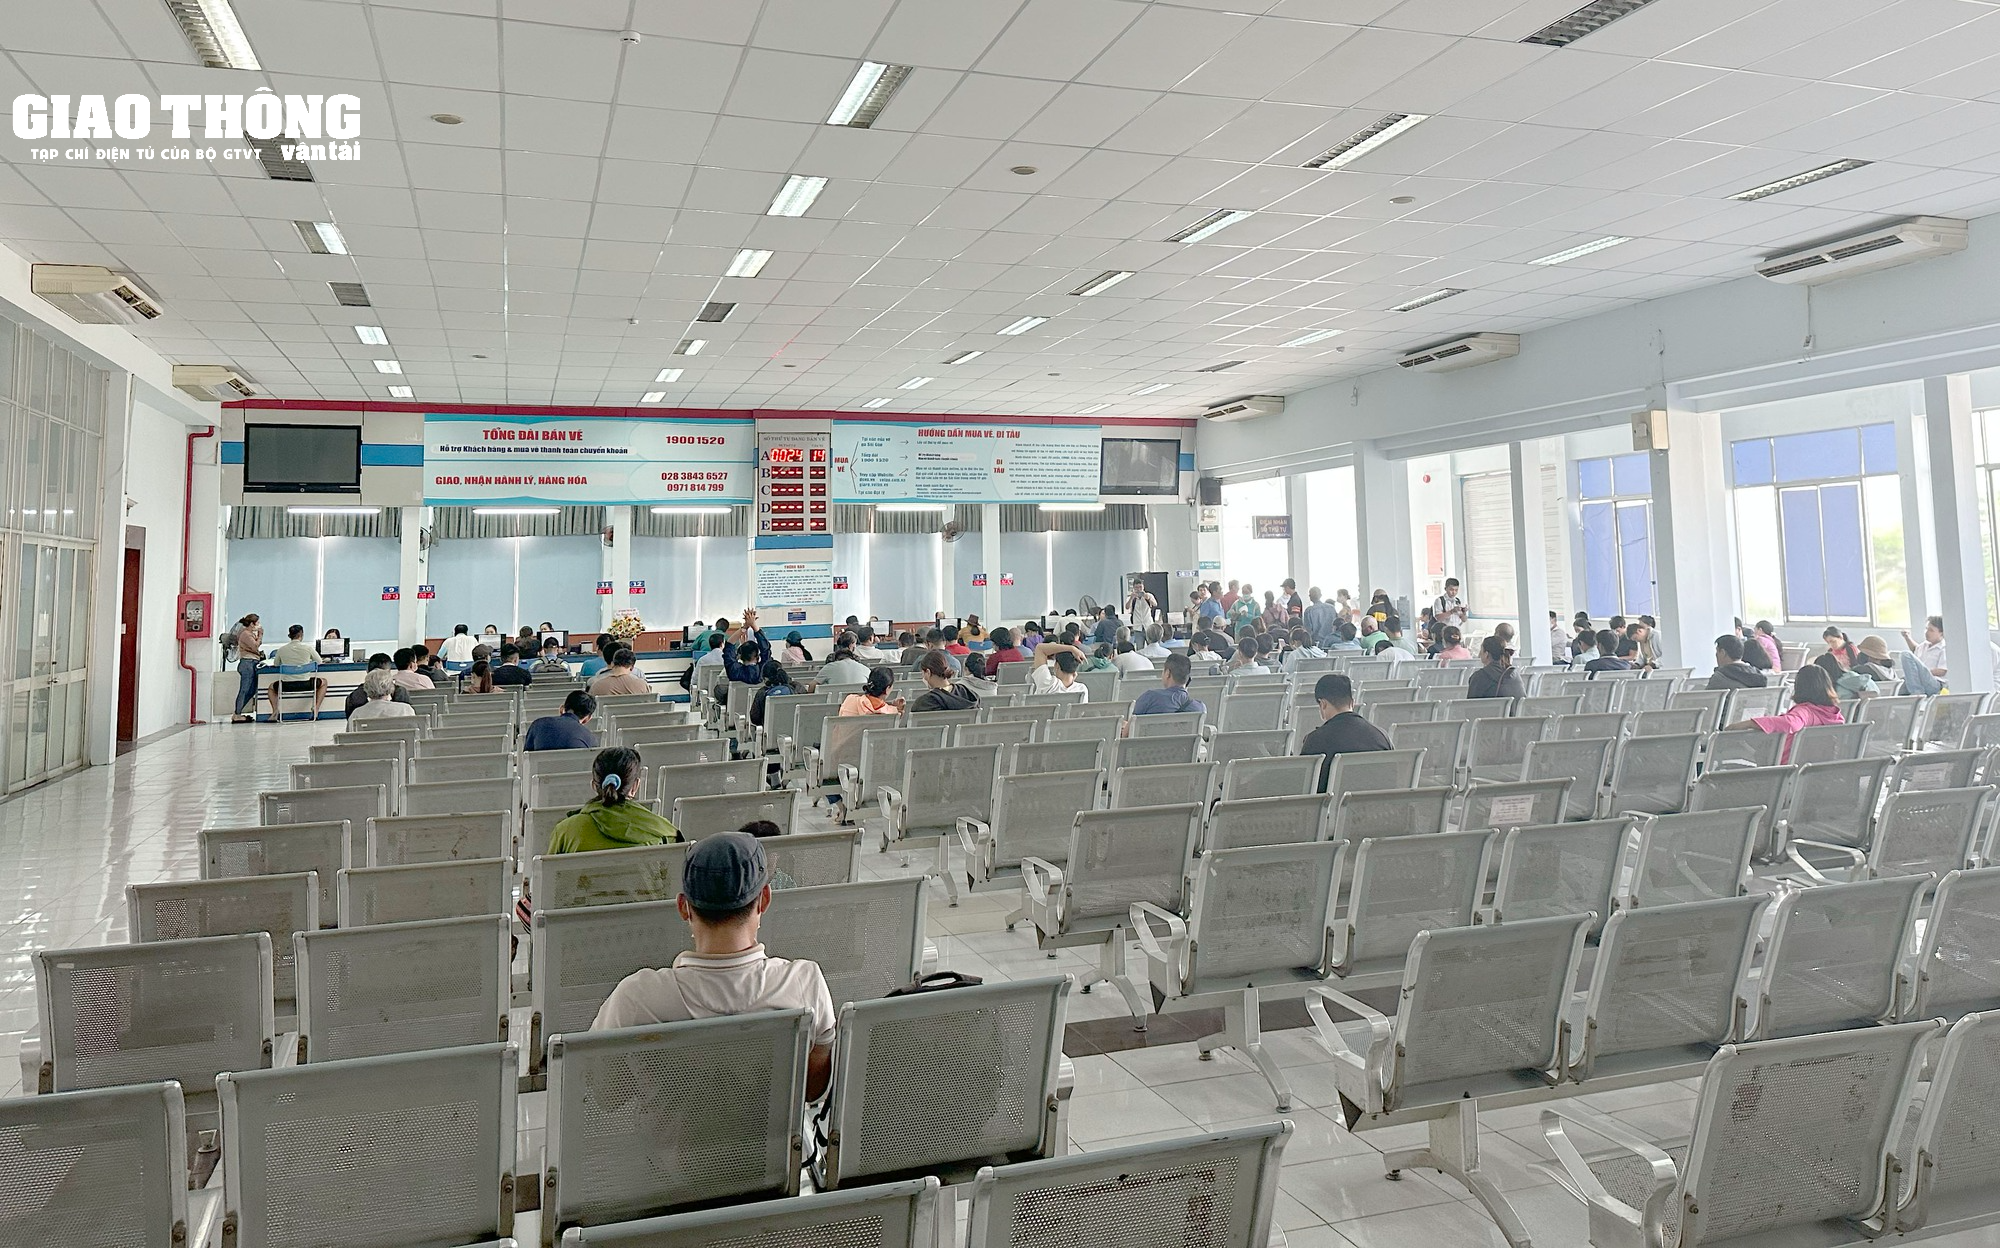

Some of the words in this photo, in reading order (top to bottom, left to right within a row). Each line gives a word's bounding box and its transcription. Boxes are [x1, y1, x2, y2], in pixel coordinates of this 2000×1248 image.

[482, 426, 516, 441] TỔNG
[518, 428, 539, 441] ĐÀI
[542, 428, 566, 441] BÁN
[568, 428, 583, 441] VÉ
[918, 428, 946, 437] HƯỚNG
[947, 428, 963, 438] DẪN
[996, 430, 1004, 438] ĐI
[1006, 429, 1020, 438] TÀU
[440, 444, 450, 452] Hỗ
[487, 446, 506, 454] hàng
[579, 446, 606, 454] chuyển
[606, 446, 628, 455] khoản
[761, 451, 770, 460] A
[770, 449, 804, 462] 0024
[813, 450, 826, 462] 14
[661, 472, 679, 480] 028
[681, 472, 704, 480] 3843
[706, 472, 728, 480] 6527
[761, 468, 770, 478] B
[435, 476, 462, 486] GIAO,
[464, 475, 492, 486] NHẬN
[494, 475, 522, 485] HÀNH
[523, 475, 536, 486] LÝ,
[538, 475, 565, 485] HÀNG
[567, 475, 587, 485] HÓA
[667, 483, 688, 491] 0971
[690, 483, 706, 491] 814
[708, 483, 724, 491] 799
[761, 485, 770, 495] C
[761, 503, 771, 513] D
[761, 520, 770, 530] E
